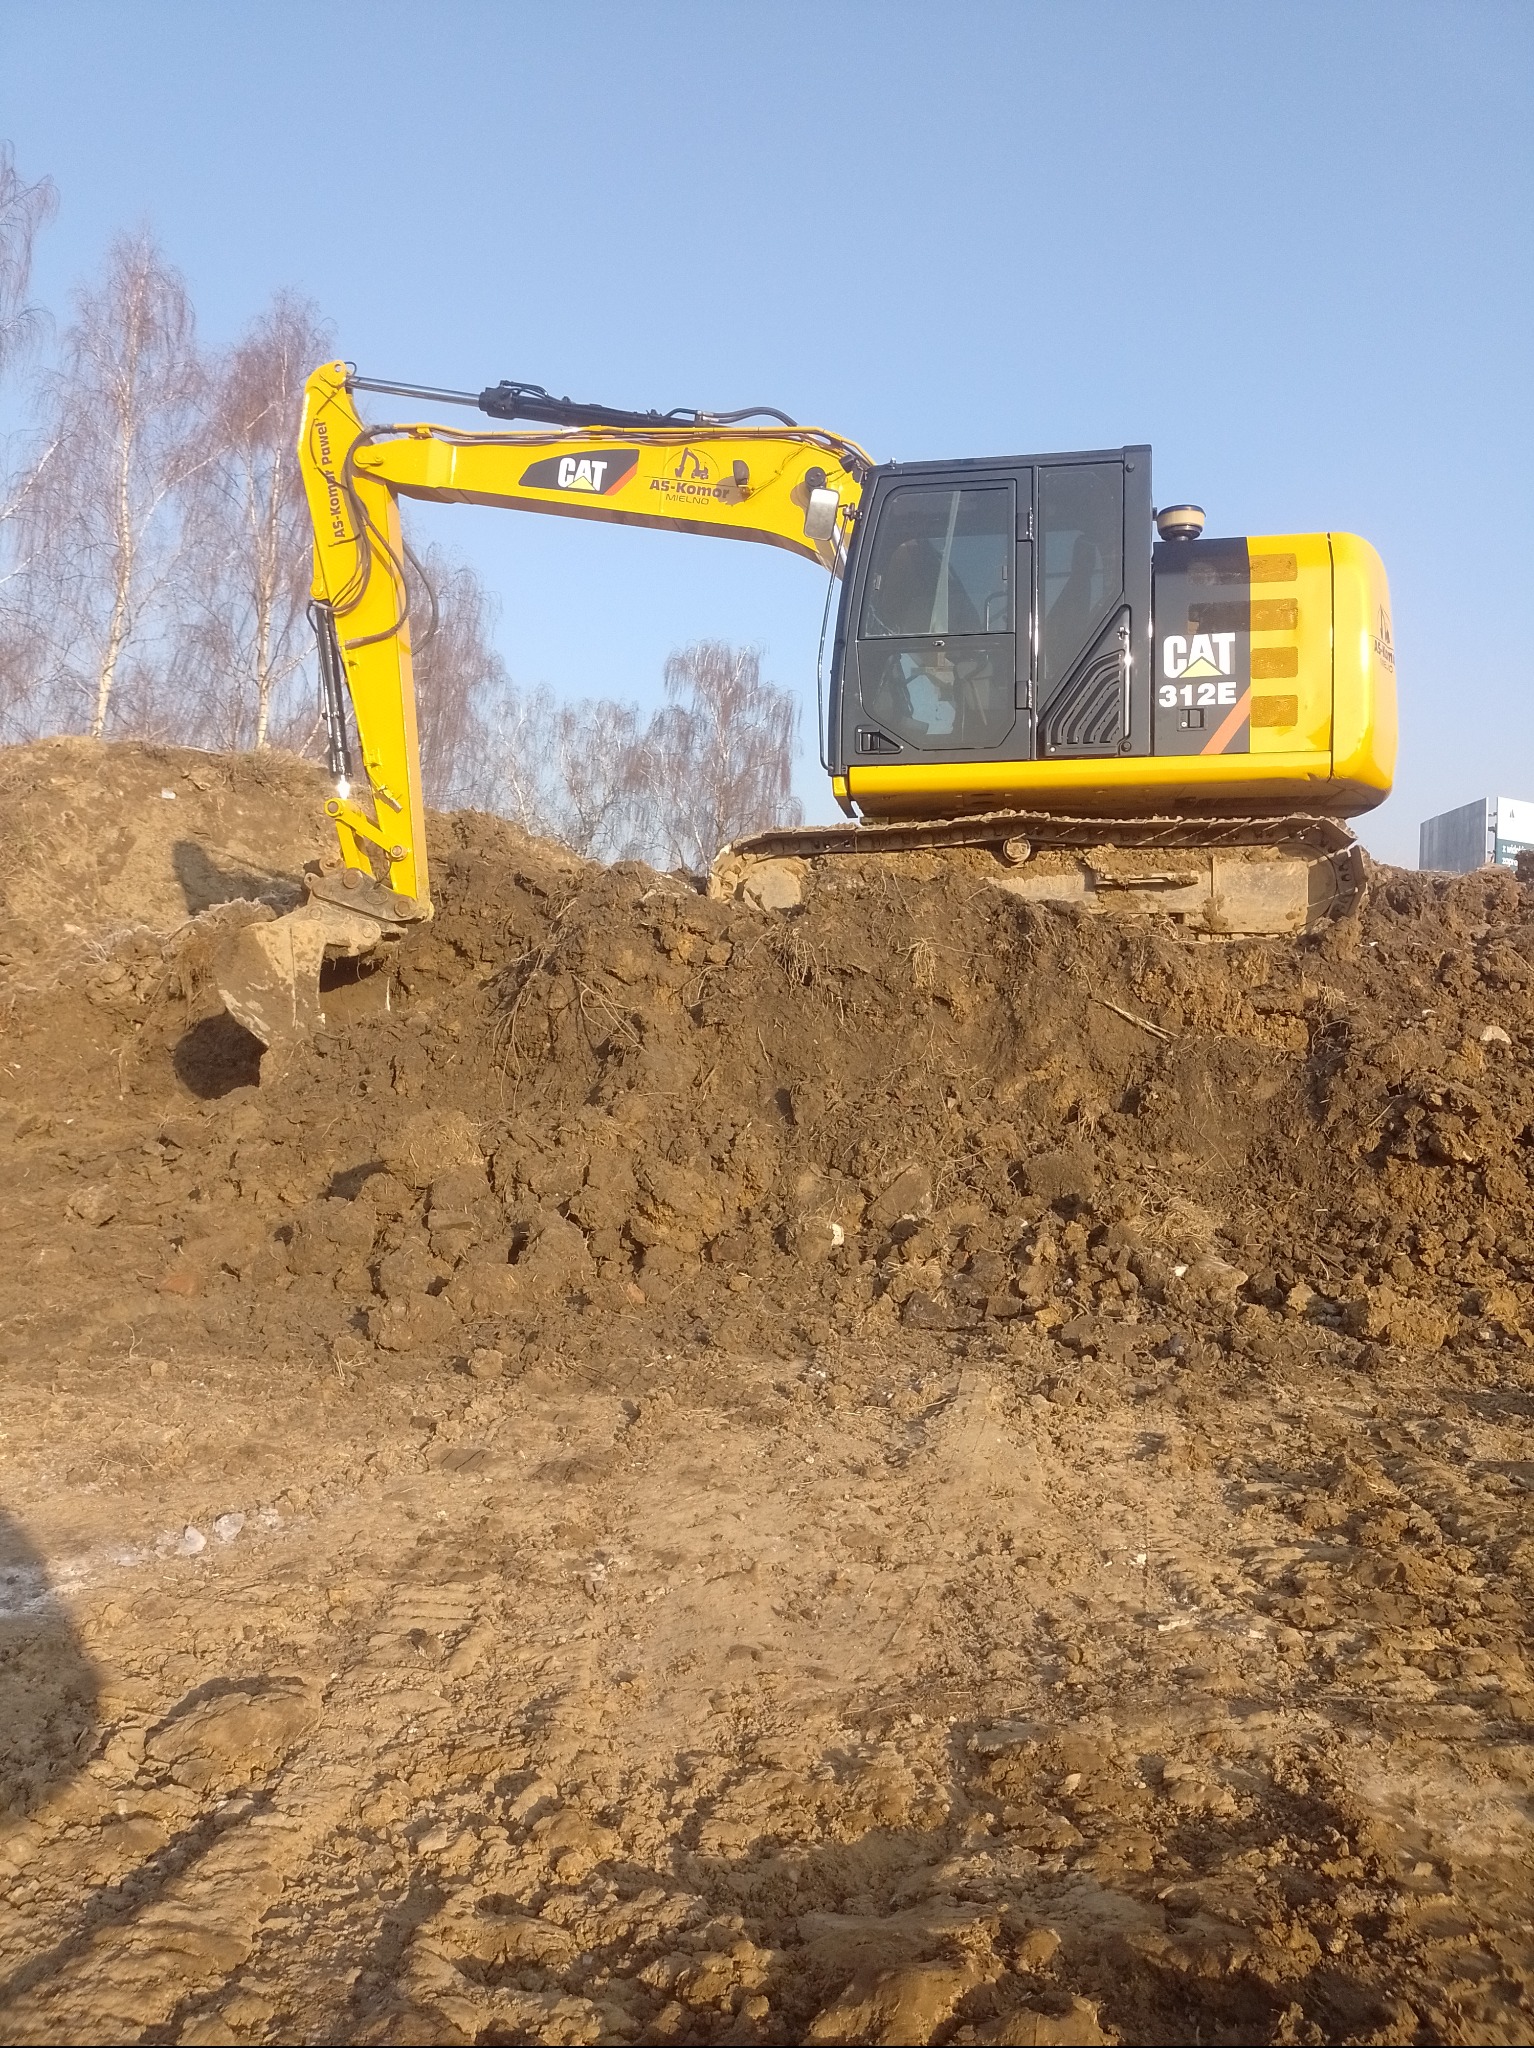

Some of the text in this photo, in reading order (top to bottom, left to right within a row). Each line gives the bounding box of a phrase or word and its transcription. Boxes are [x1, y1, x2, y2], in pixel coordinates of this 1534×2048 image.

[558, 457, 607, 492] CAT
[649, 479, 730, 499] AS-Komor
[665, 493, 710, 506] MIELNO
[1163, 632, 1236, 679] CAT
[1158, 681, 1237, 708] 312E
